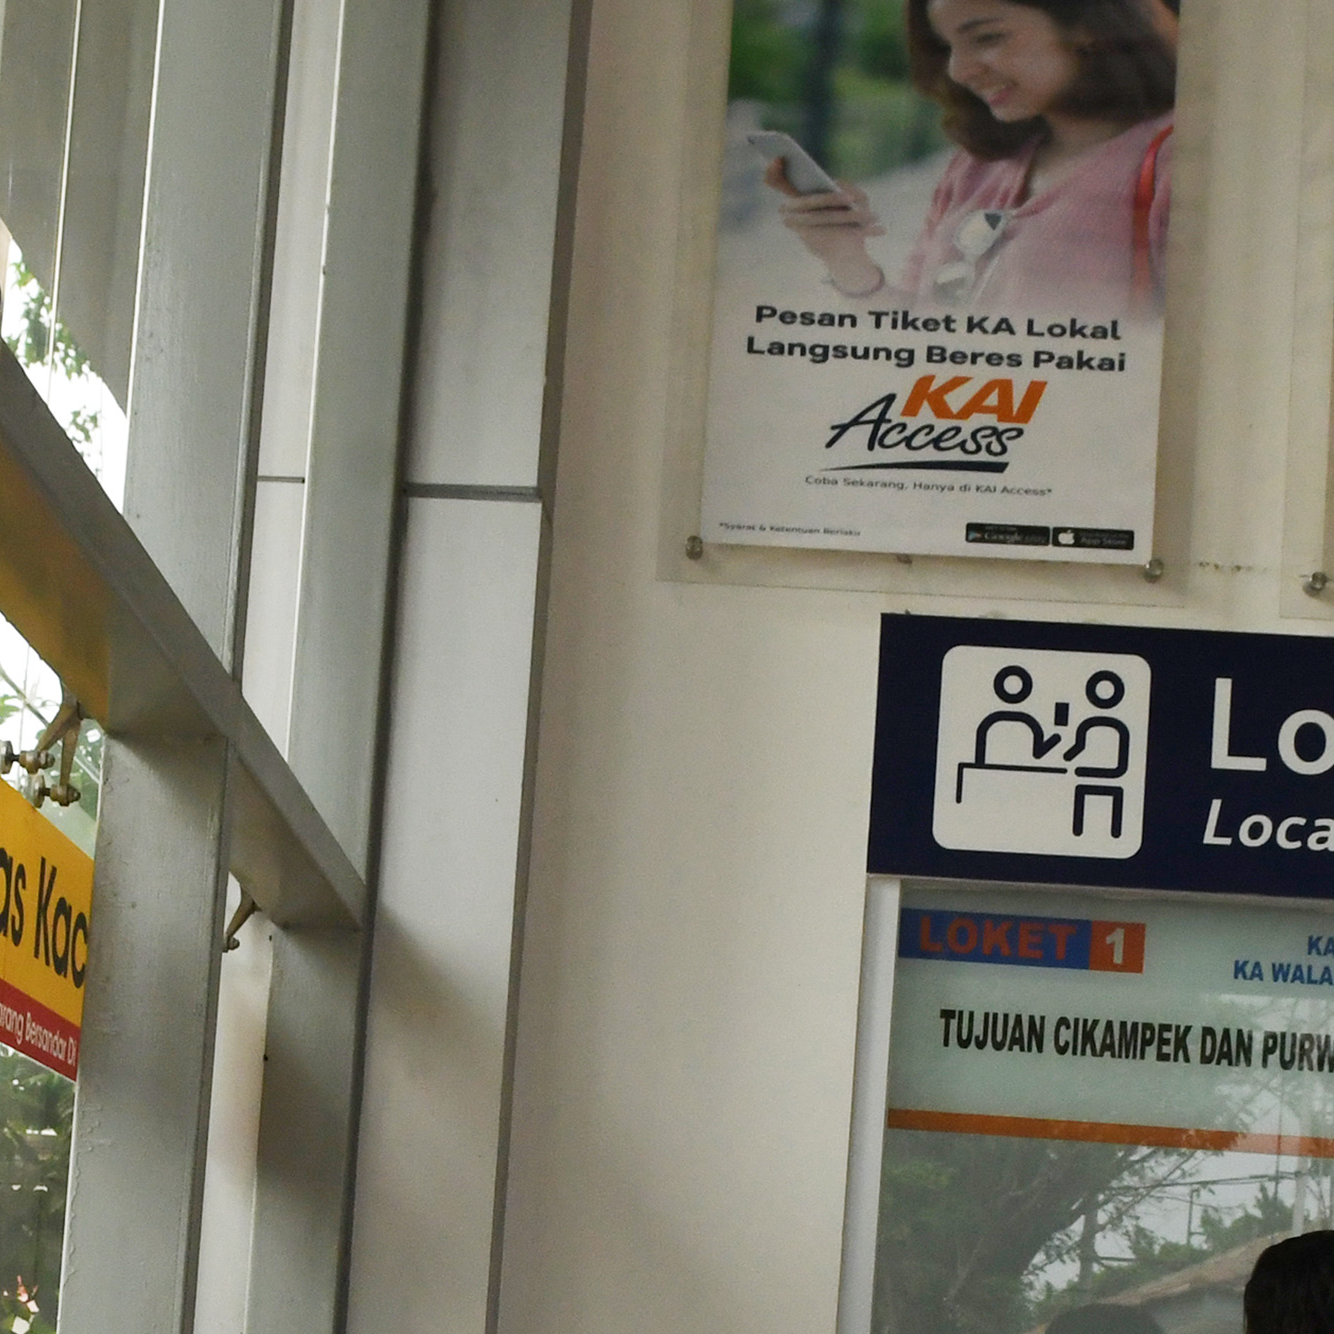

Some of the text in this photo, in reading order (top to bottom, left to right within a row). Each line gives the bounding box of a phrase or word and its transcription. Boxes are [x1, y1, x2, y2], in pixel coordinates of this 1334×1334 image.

[755, 304, 1122, 342] Pesan Tiket KA Lokal
[746, 335, 1126, 372] Langsung Beres Pakai
[900, 374, 1048, 425] KAI
[825, 393, 1025, 458] Access
[919, 916, 1125, 966] LOKET 1
[1233, 959, 1264, 982] KA
[25, 1012, 68, 1060] Bersandar
[939, 1008, 1046, 1056] TUJUAN
[1053, 1016, 1192, 1065] CIKAMPEK
[1200, 1026, 1253, 1069] DAN
